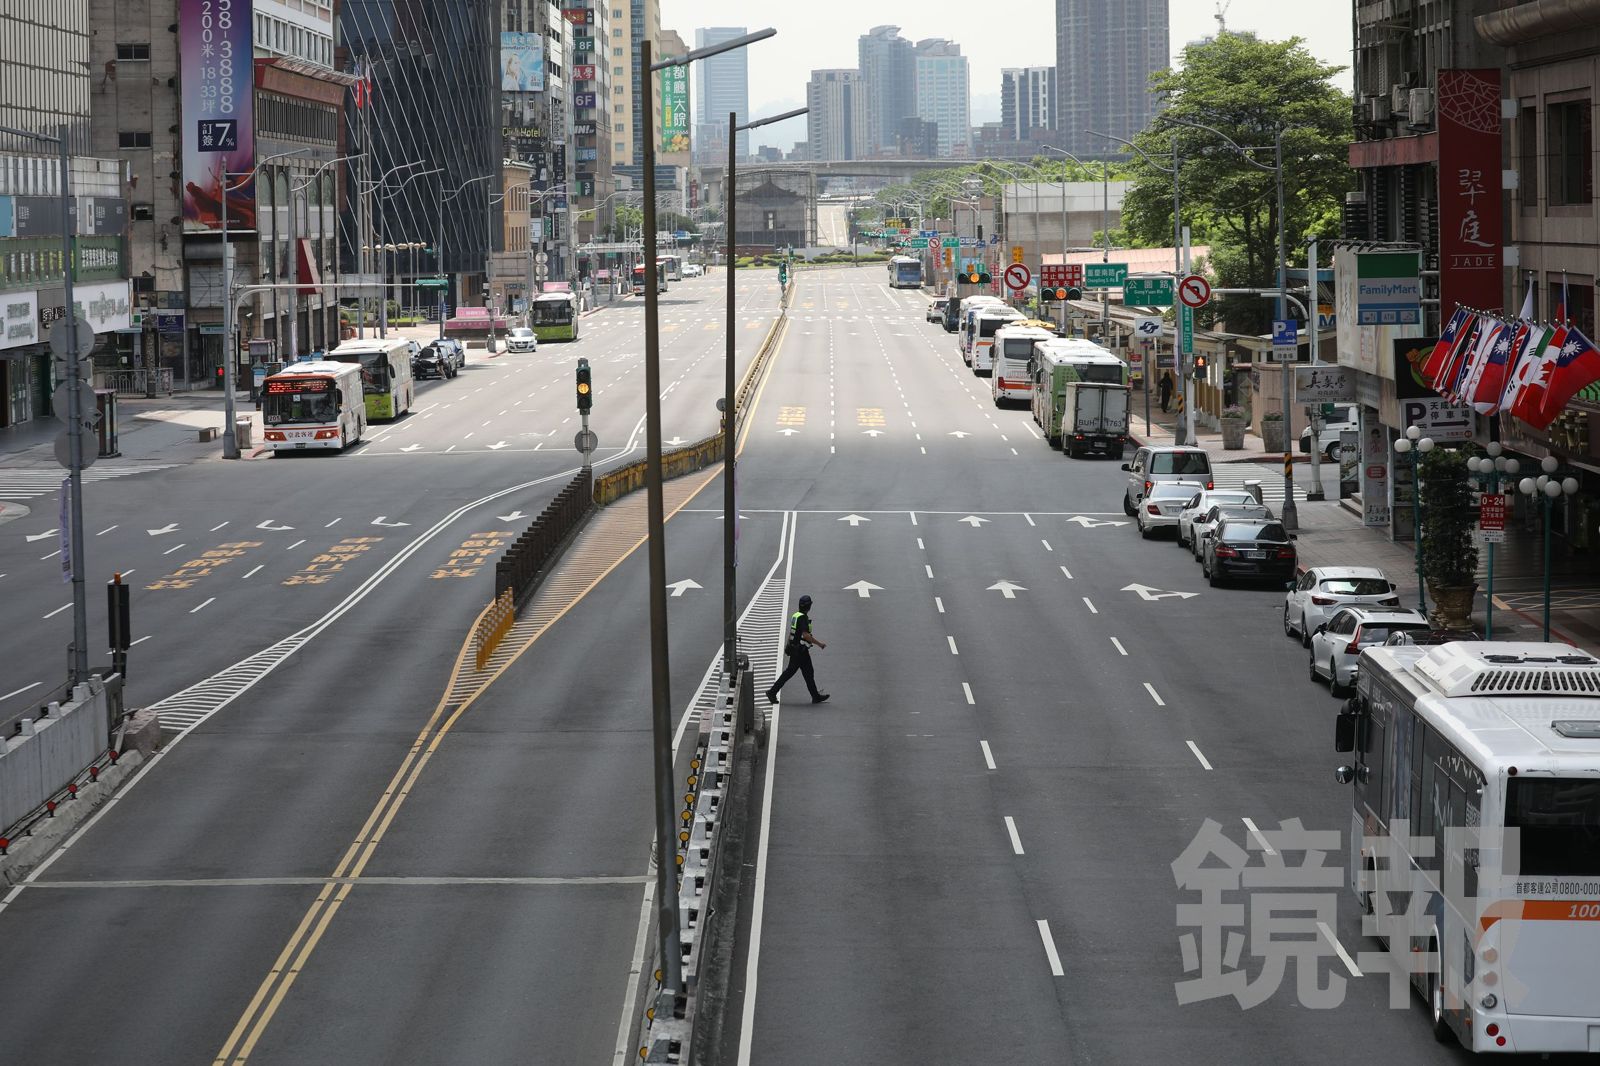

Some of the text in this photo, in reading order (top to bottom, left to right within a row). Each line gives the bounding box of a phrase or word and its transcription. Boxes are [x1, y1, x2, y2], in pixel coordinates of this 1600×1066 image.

[579, 41, 592, 50] 8F
[575, 95, 592, 106] 6F
[1458, 168, 1496, 249] 翠庭
[1452, 256, 1496, 268] JADE
[1087, 268, 1115, 277] 重慶南路
[1128, 280, 1169, 289] 公園路
[1359, 284, 1418, 297] FamilyMart
[1273, 321, 1287, 338] P
[1405, 402, 1427, 429] P
[1430, 410, 1470, 420] 停車場
